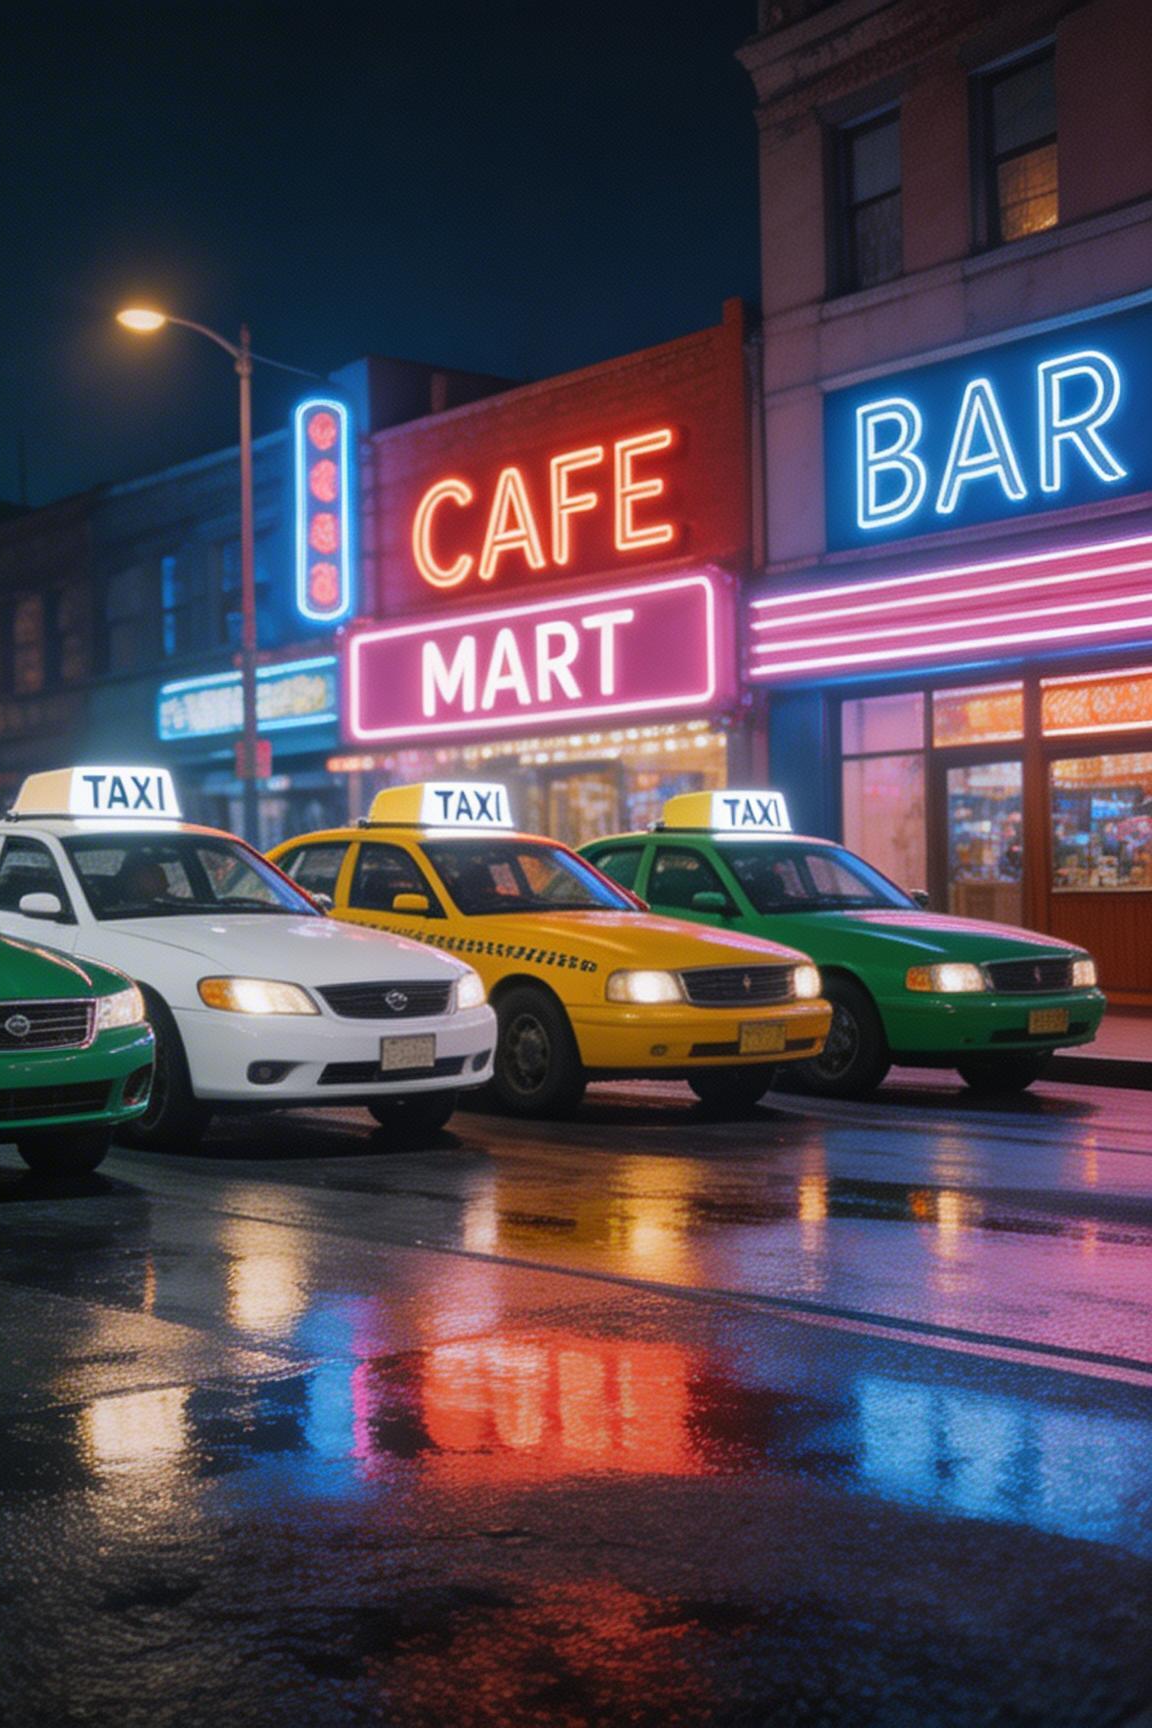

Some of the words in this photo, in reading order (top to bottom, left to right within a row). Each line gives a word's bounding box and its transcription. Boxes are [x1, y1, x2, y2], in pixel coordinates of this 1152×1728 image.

[854, 349, 1128, 531] BAR
[411, 427, 676, 590] CAFE
[420, 607, 636, 719] MART
[82, 775, 166, 811] TAXI
[433, 790, 503, 822] TAXI
[722, 799, 781, 827] TAXI
